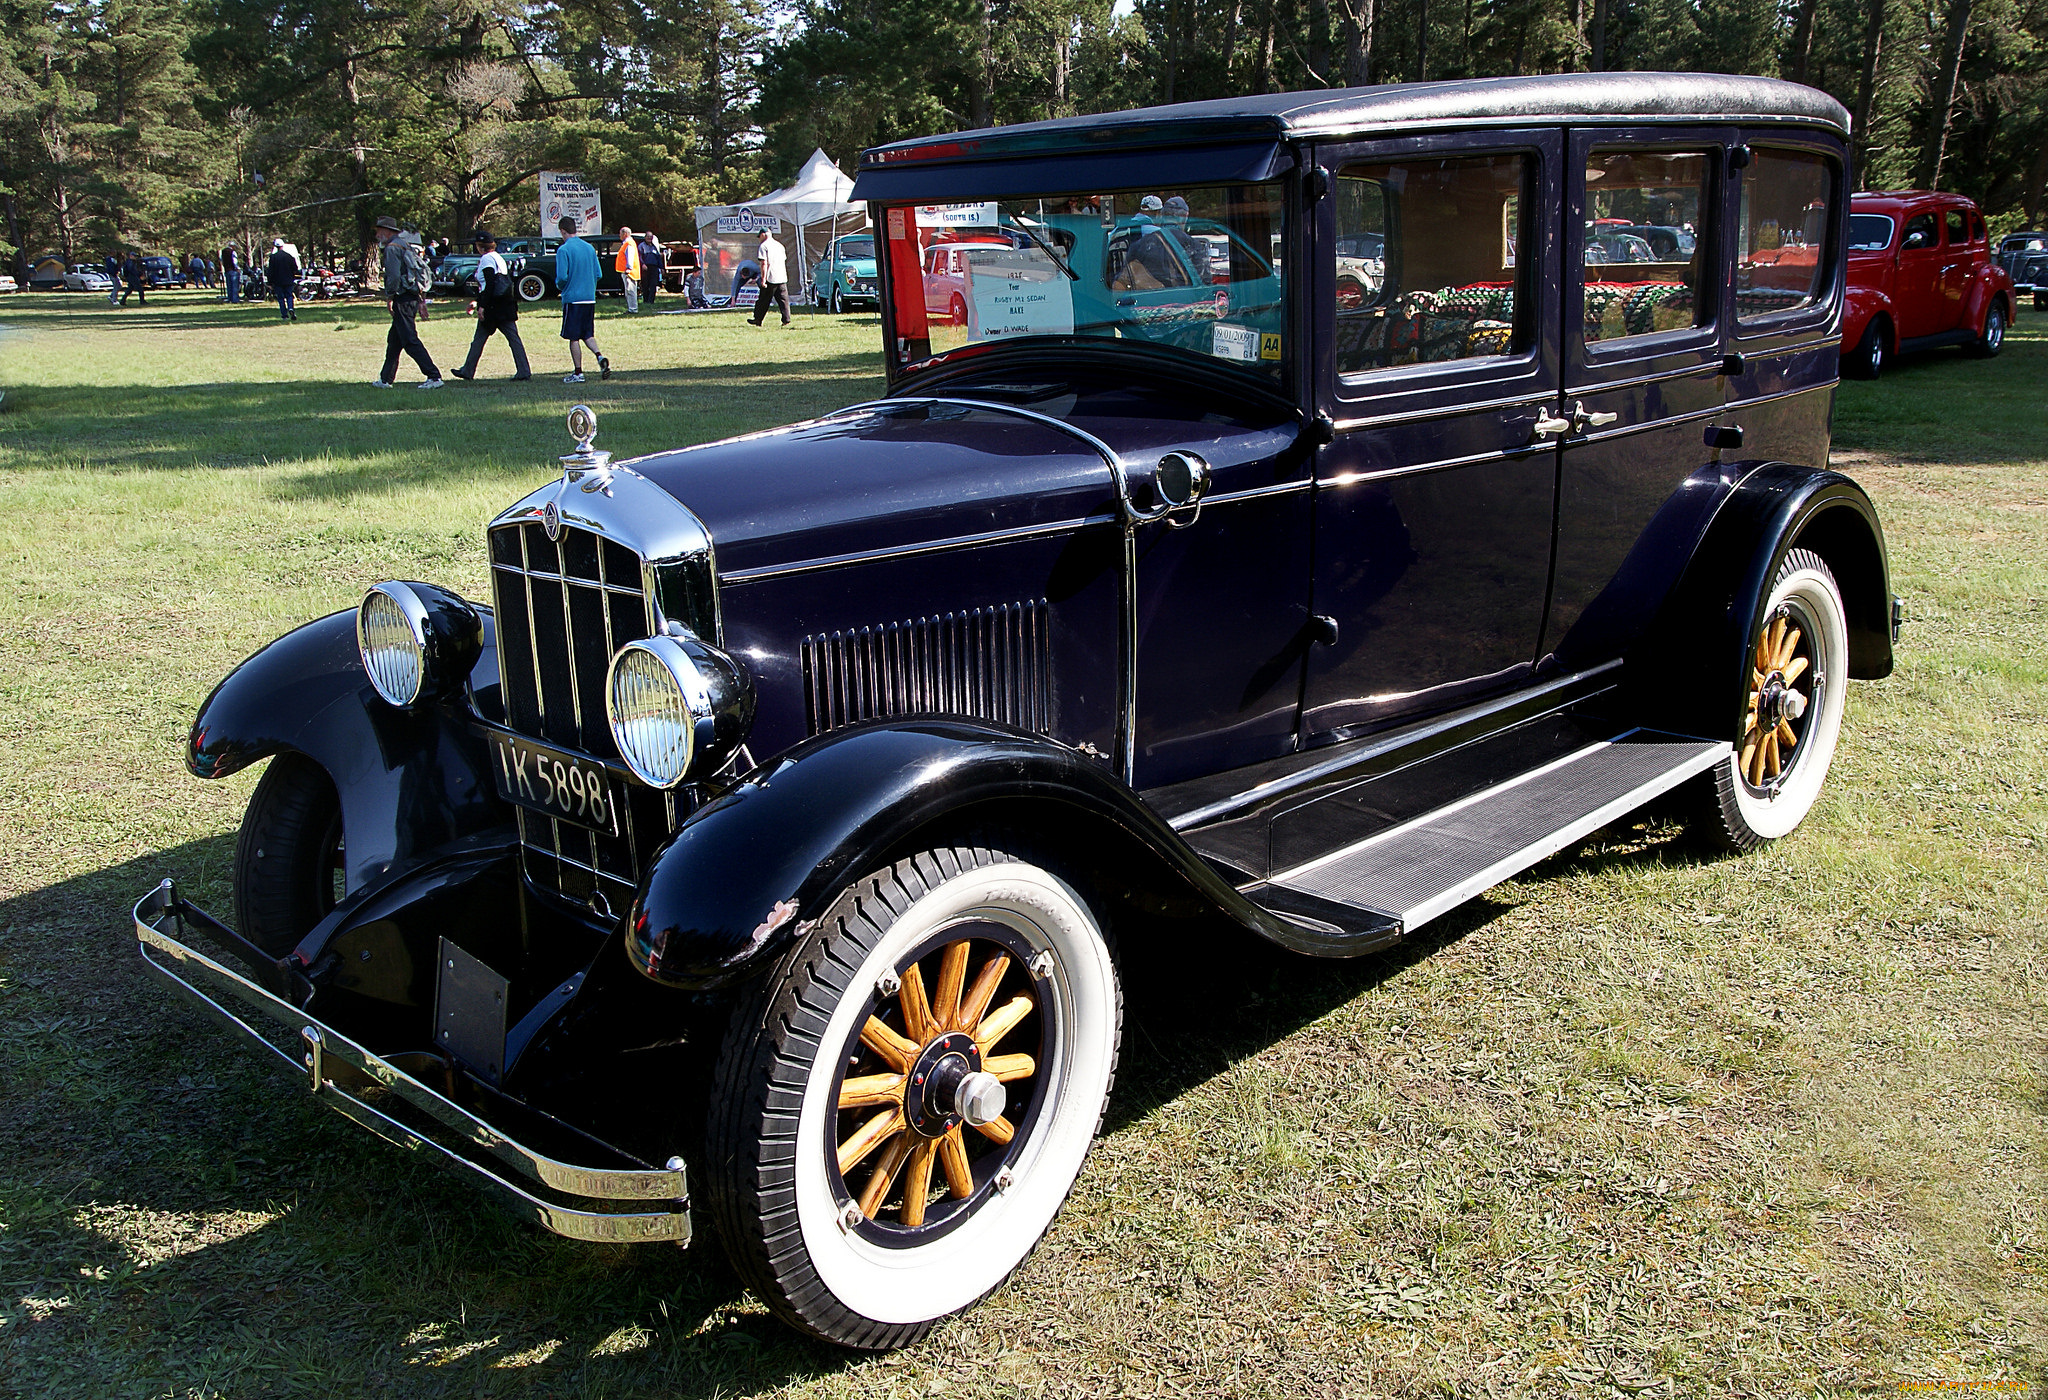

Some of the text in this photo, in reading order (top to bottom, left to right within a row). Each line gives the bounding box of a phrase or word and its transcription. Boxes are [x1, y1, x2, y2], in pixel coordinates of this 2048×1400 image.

[718, 217, 740, 226] MORRIS
[753, 217, 777, 226] OWNERS
[1009, 283, 1020, 291] Year
[1026, 294, 1046, 303] SEDAN
[1009, 306, 1024, 315] MAKE
[1011, 324, 1029, 333] WADE
[1263, 337, 1279, 352] AA
